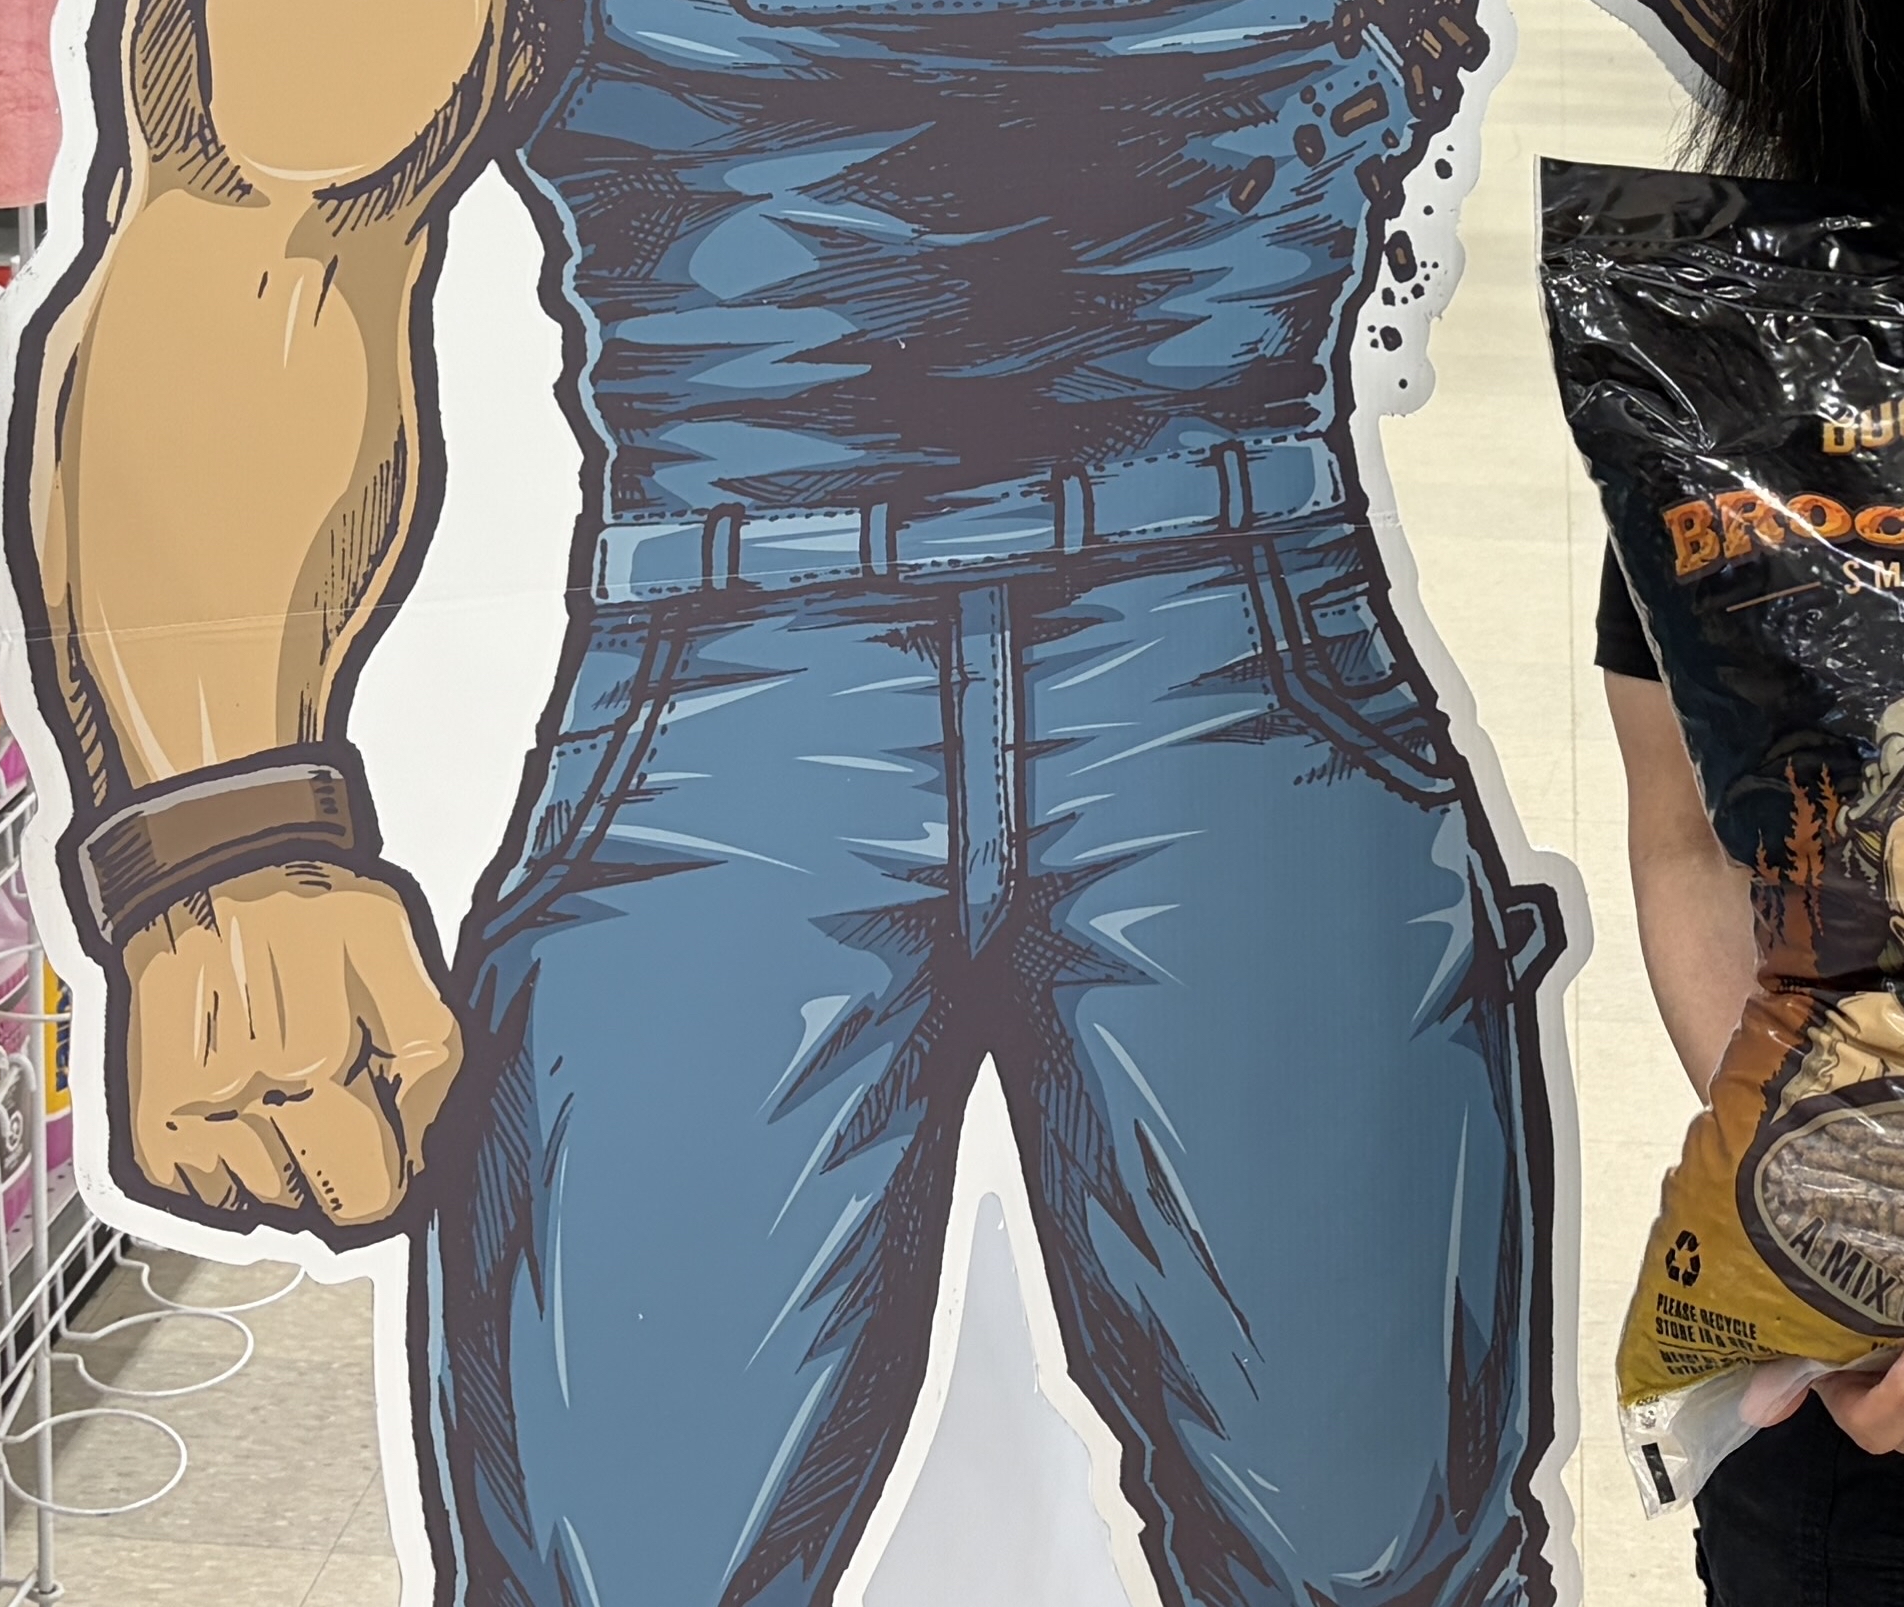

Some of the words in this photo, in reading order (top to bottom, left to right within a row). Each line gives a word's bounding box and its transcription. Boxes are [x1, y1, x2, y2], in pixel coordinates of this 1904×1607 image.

[1790, 1216, 1827, 1260] A
[1819, 1245, 1897, 1314] MIX
[1655, 1292, 1698, 1323] PLEASE
[1699, 1307, 1757, 1340] RECYCLE
[1655, 1316, 1696, 1341] STORE
